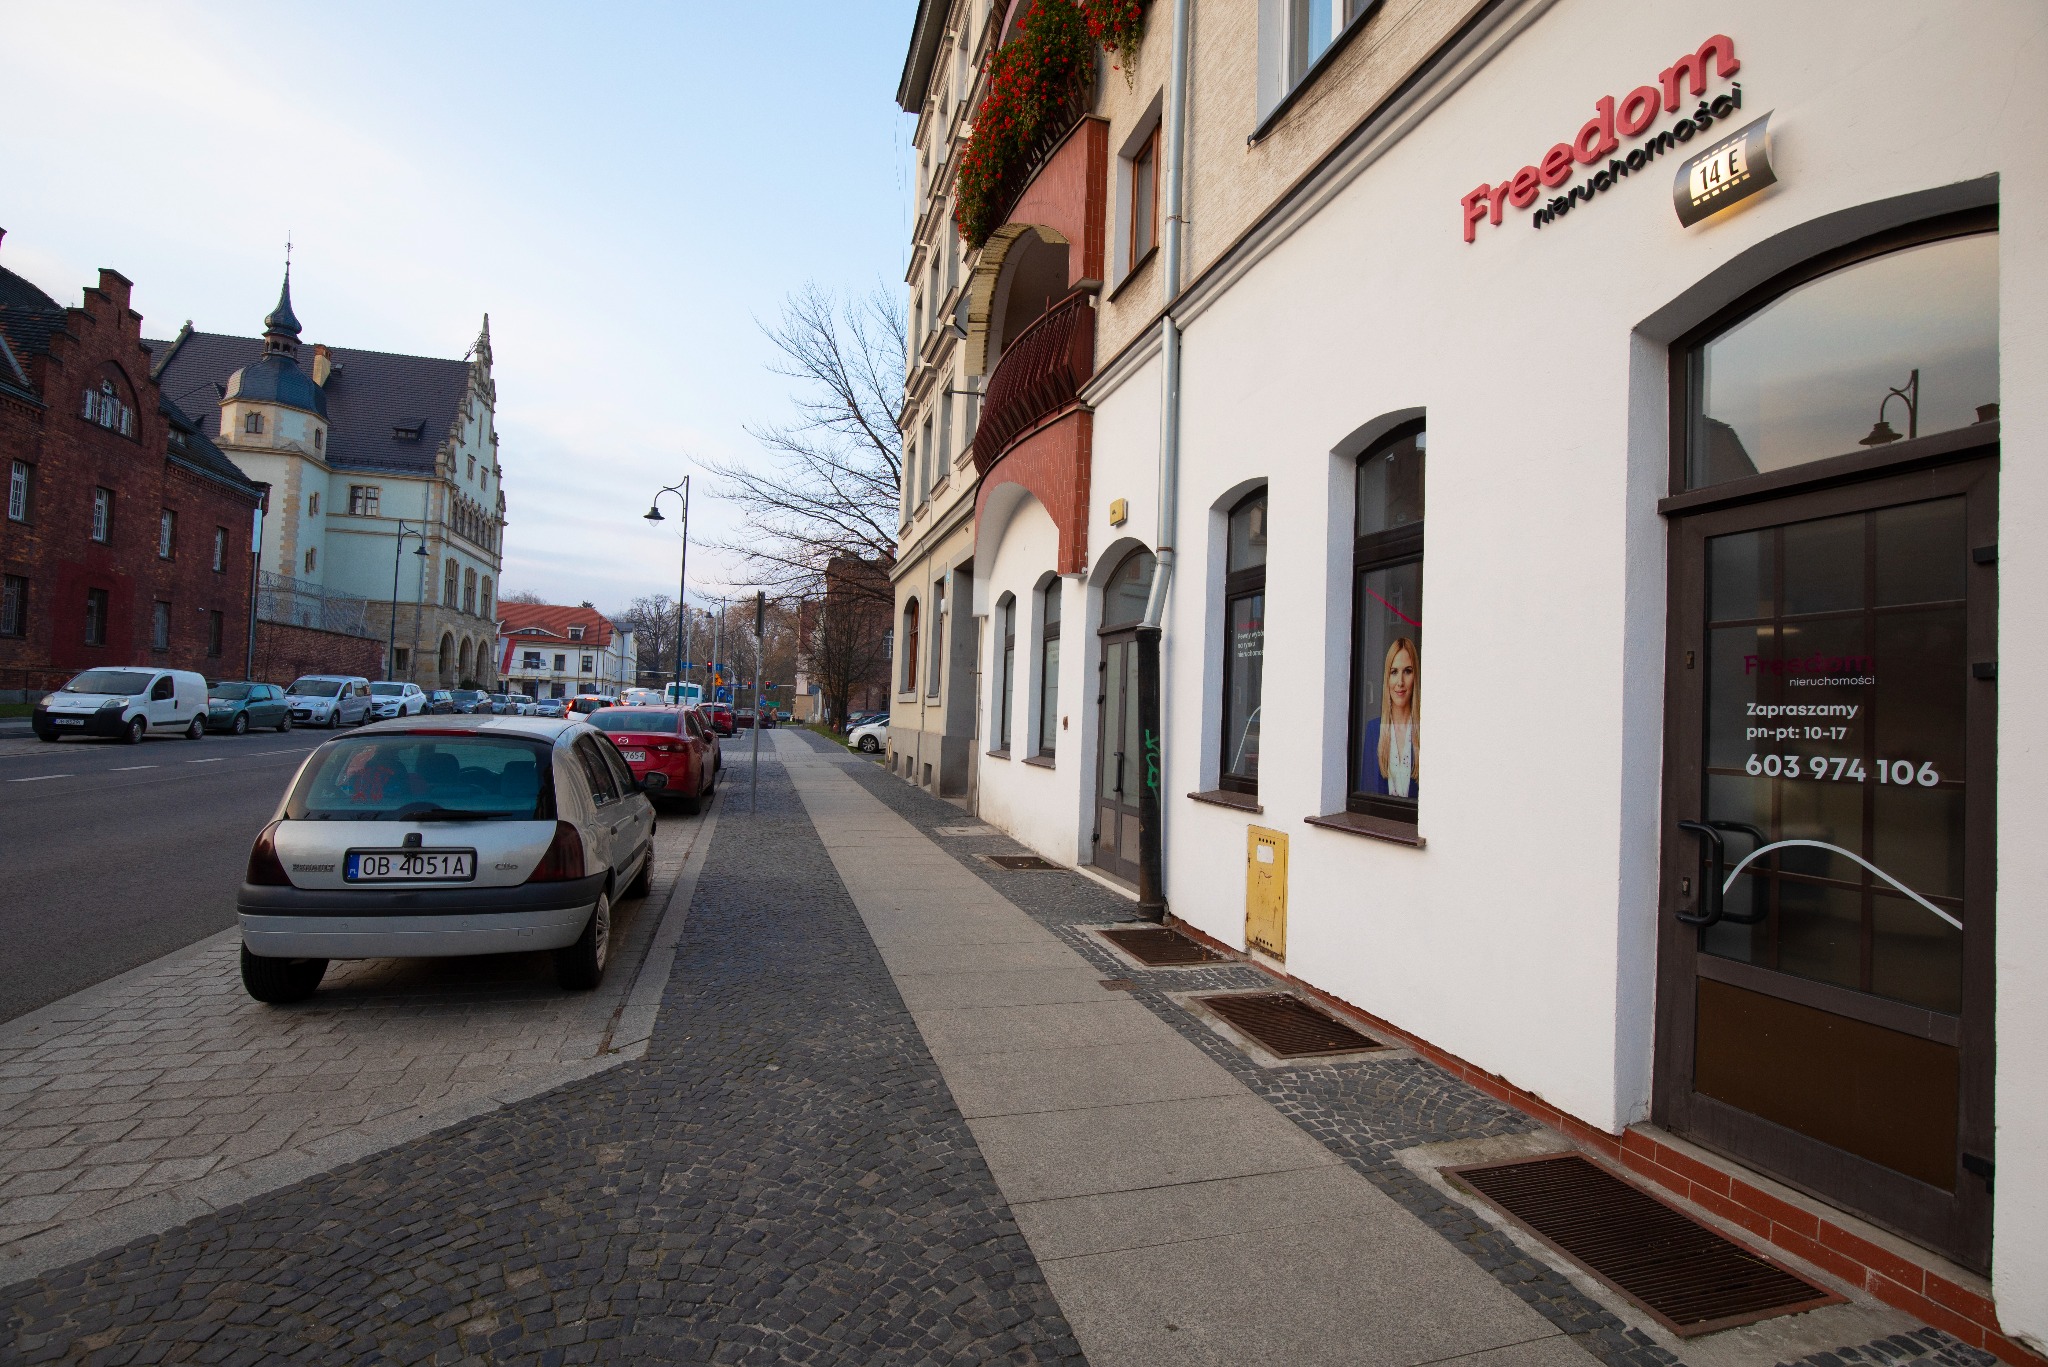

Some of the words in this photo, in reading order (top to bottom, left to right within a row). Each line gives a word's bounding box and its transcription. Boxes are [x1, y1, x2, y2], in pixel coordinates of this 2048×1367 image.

[1461, 34, 1741, 243] Freedom
[1533, 81, 1742, 230] nieruchomości
[1699, 160, 1721, 190] 14
[1728, 148, 1739, 176] E
[1743, 652, 1874, 676] Freedom
[1789, 675, 1875, 687] nieruchomości
[1746, 703, 1859, 719] Zapraszamy
[1746, 726, 1800, 741] pn-pt:
[1803, 726, 1847, 740] 10-17
[1745, 753, 1800, 778] 603
[1809, 756, 1866, 782] 974
[1876, 759, 1939, 787] 106
[292, 864, 335, 873] RENAULT
[363, 856, 390, 876] OB
[399, 856, 464, 876] 4051A
